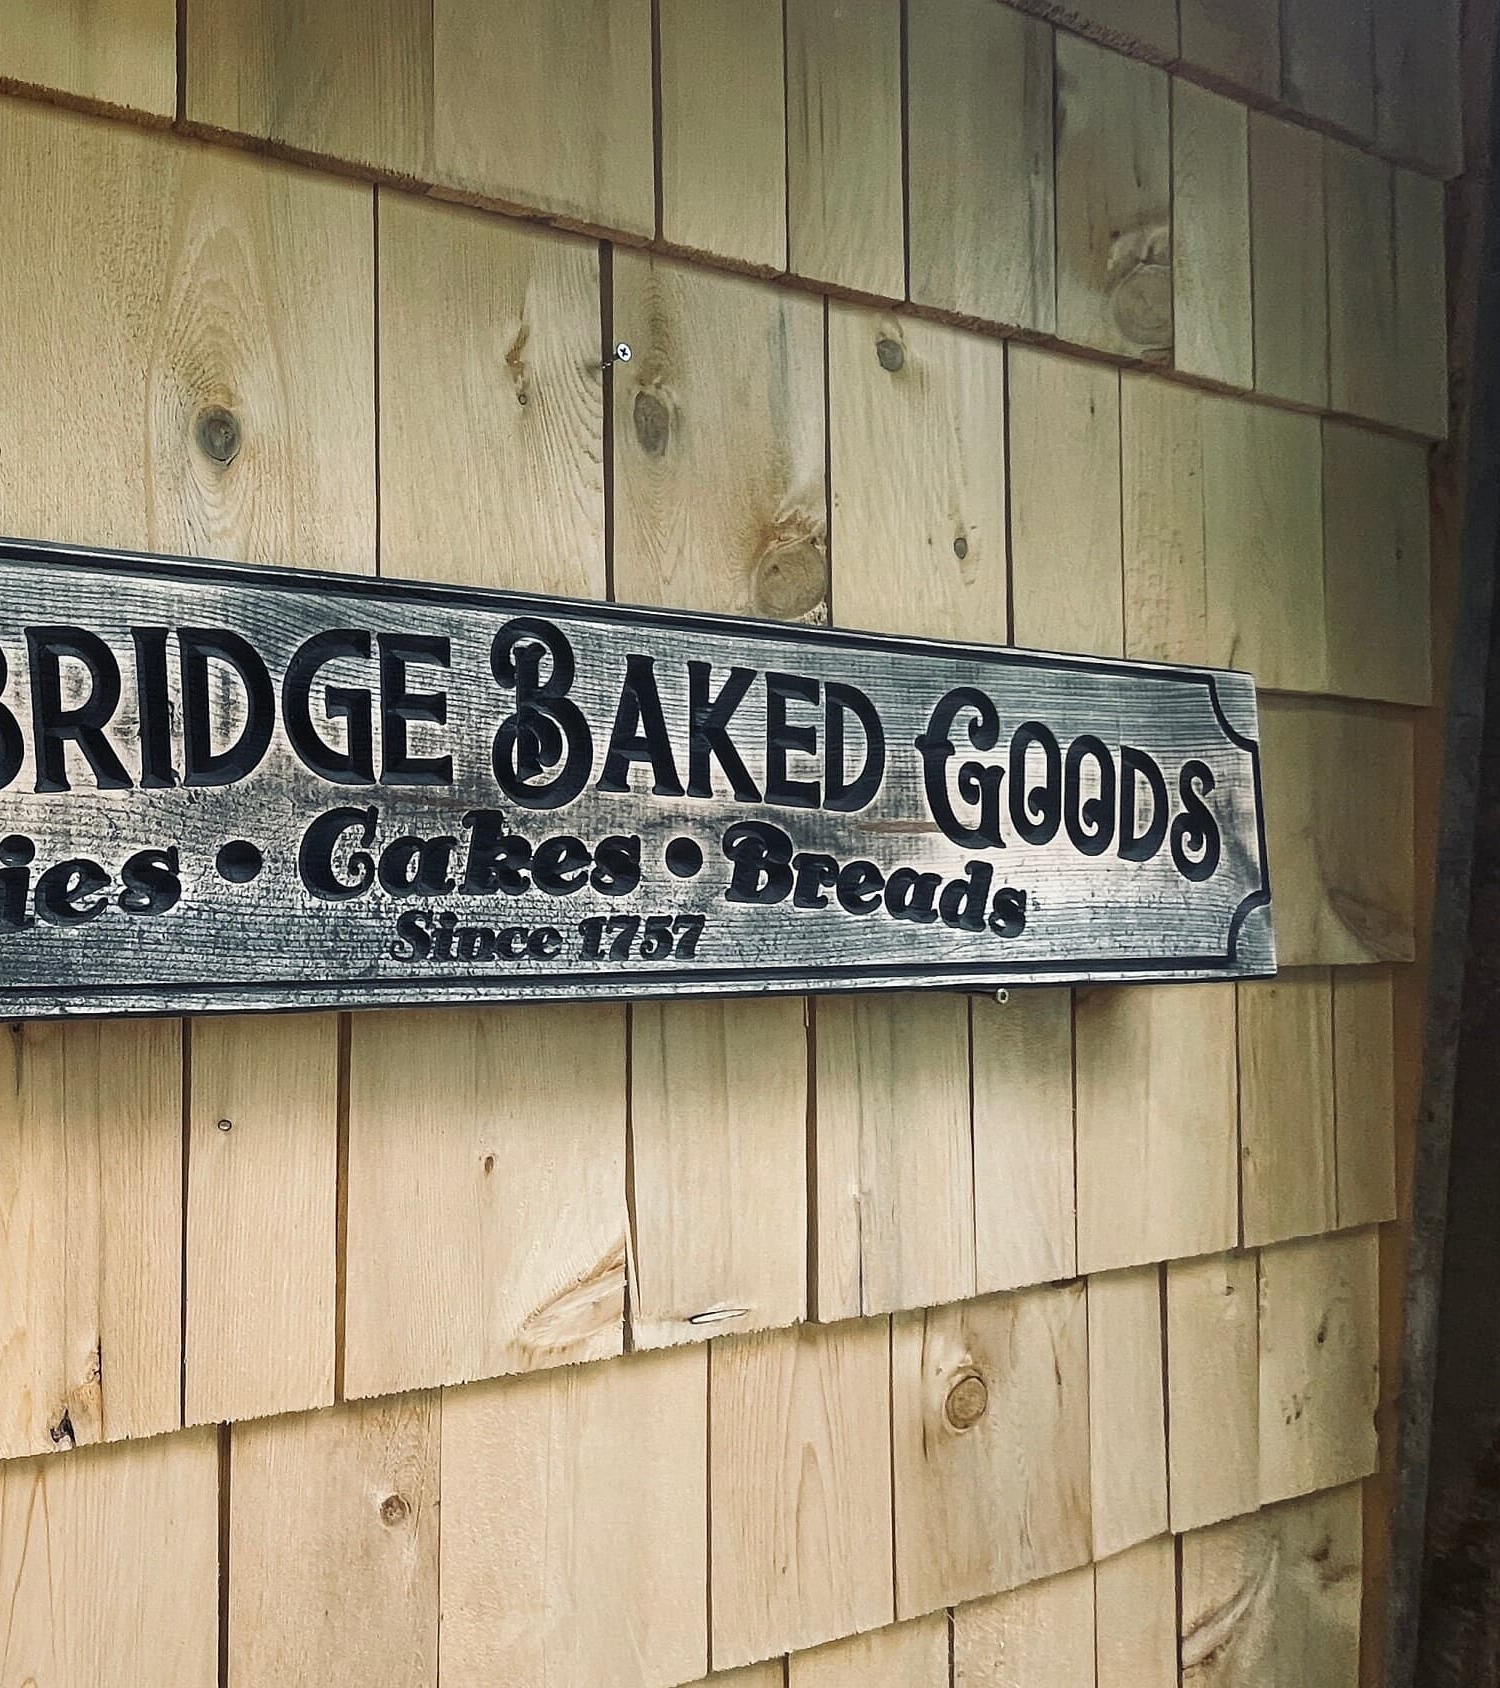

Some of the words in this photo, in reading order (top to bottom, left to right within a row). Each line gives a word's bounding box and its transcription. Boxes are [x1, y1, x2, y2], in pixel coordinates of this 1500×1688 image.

[490, 617, 886, 812] BAKED
[914, 686, 1221, 882] GOODS
[299, 805, 641, 901] Cakes
[722, 820, 1027, 938] Breads
[389, 909, 564, 961] Since
[578, 914, 706, 961] 1757
